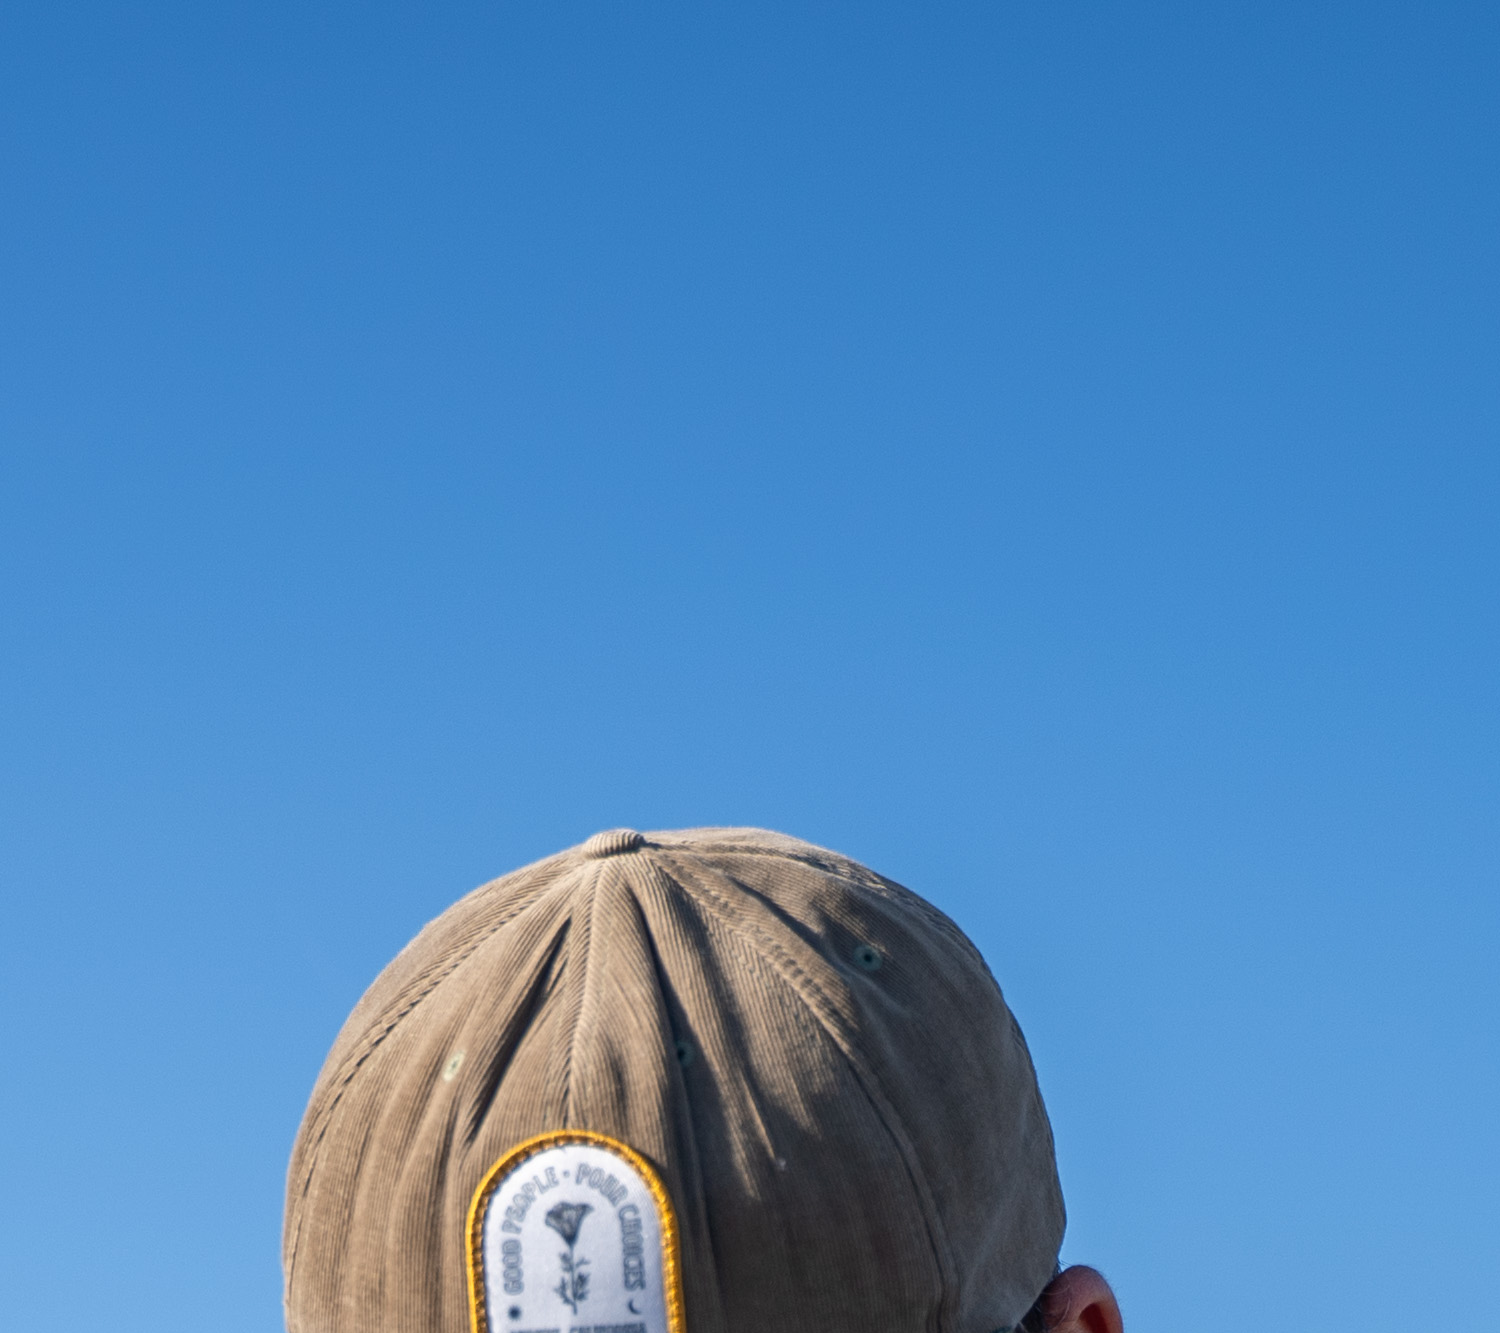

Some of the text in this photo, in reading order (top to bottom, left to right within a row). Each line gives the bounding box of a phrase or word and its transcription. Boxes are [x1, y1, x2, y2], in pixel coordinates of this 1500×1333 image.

[501, 1166, 560, 1234] PEOPLE
[501, 1238, 525, 1295] GOOD
[618, 1204, 646, 1291] CHOICES
